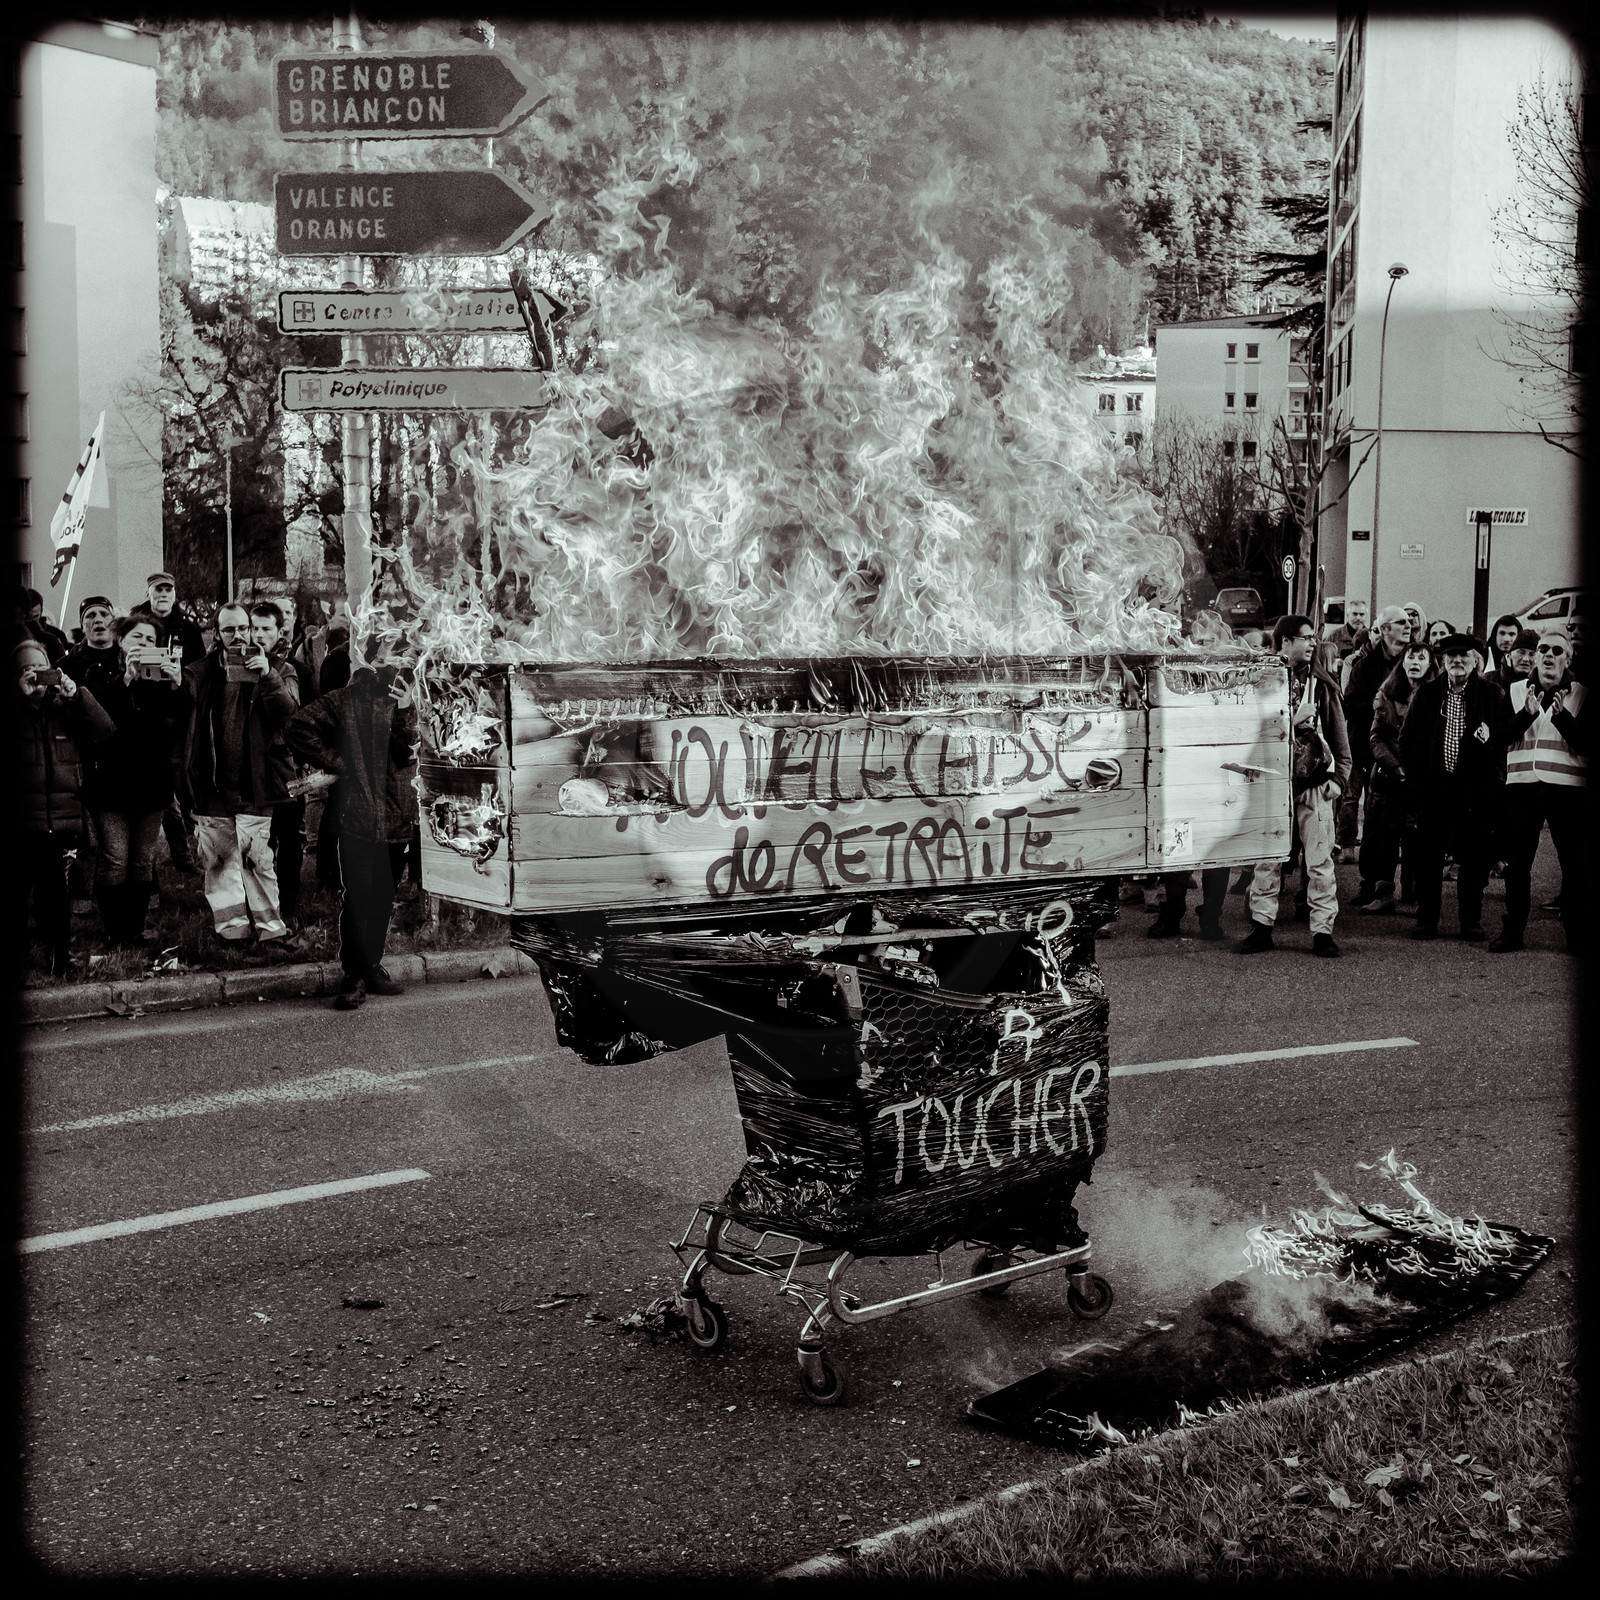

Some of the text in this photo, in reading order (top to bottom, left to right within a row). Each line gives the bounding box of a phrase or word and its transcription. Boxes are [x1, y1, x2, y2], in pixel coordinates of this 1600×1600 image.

[288, 62, 451, 93] GRENOBLE
[289, 186, 395, 209] VALENCE
[289, 217, 387, 240] ORANGE
[324, 303, 393, 321] Centre
[329, 380, 448, 403] Polyclinique
[706, 825, 785, 899] de
[878, 1061, 1101, 1185] TOUCHER
